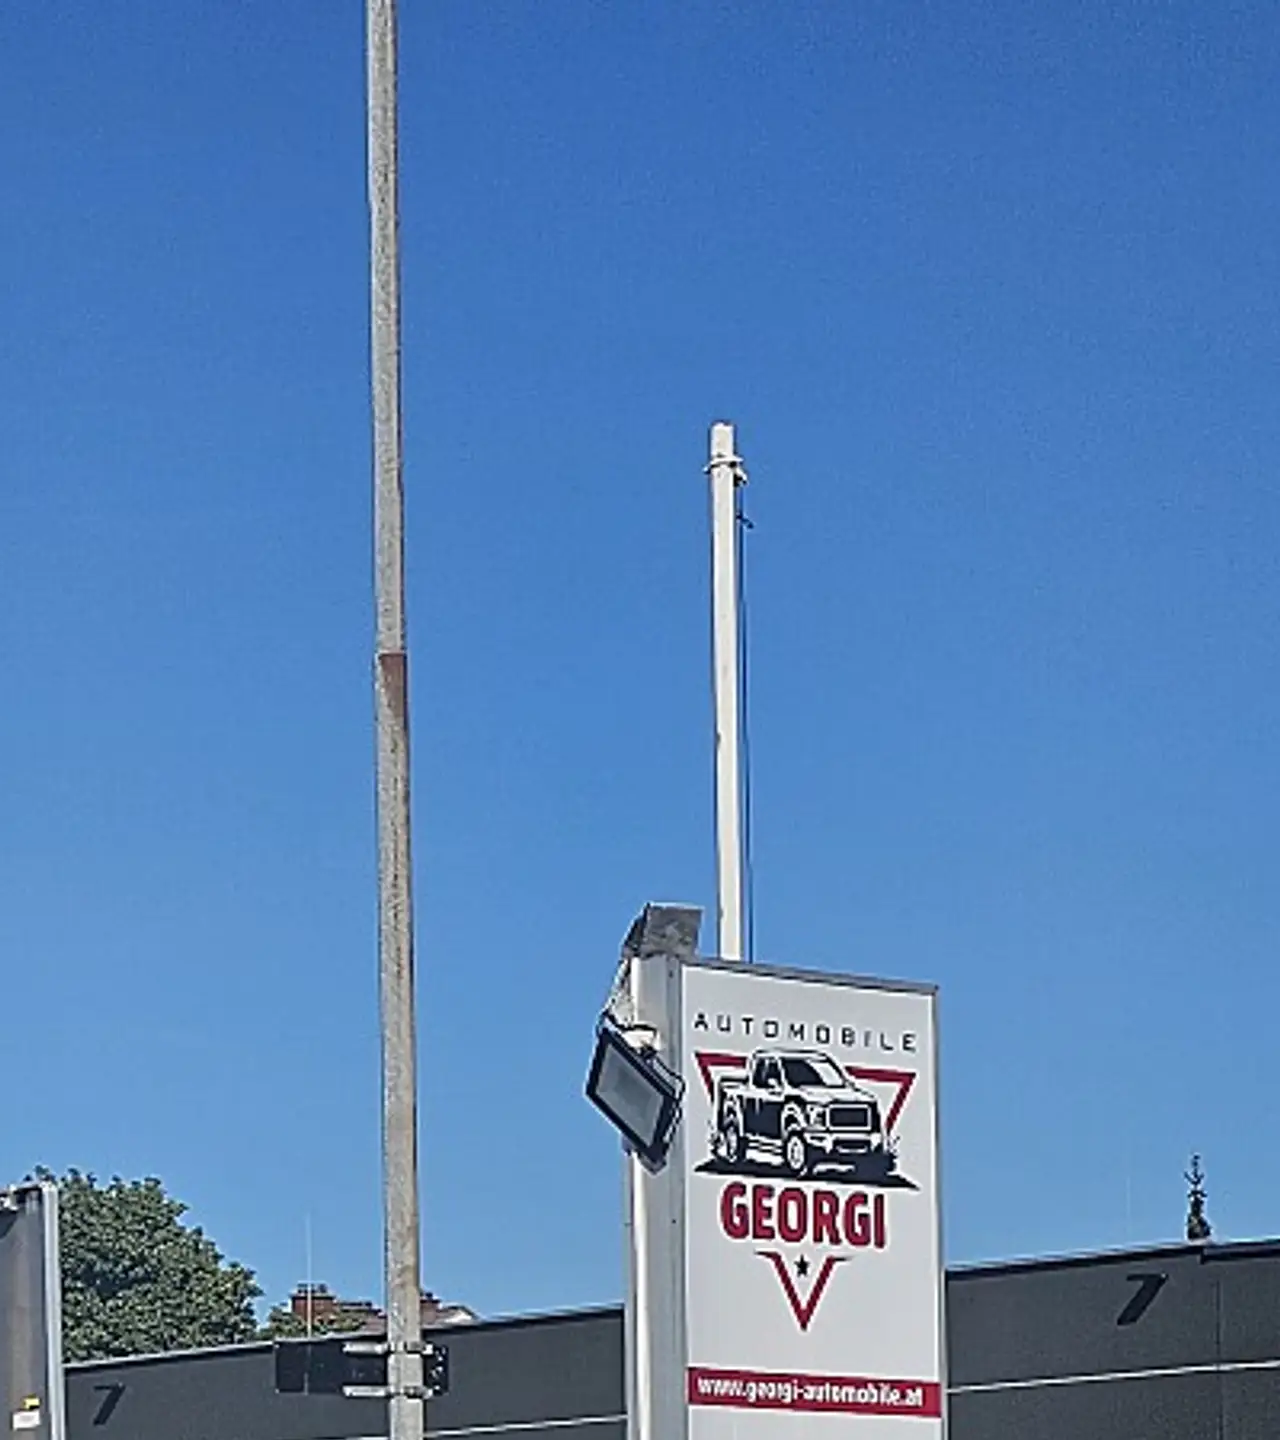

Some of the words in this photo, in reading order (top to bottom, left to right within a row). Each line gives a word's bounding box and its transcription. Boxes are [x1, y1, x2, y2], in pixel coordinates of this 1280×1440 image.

[694, 1012, 918, 1052] AUTOMOBILE
[721, 1181, 886, 1248] GEORGI
[697, 1376, 924, 1408] www.georgi-automobile.at
